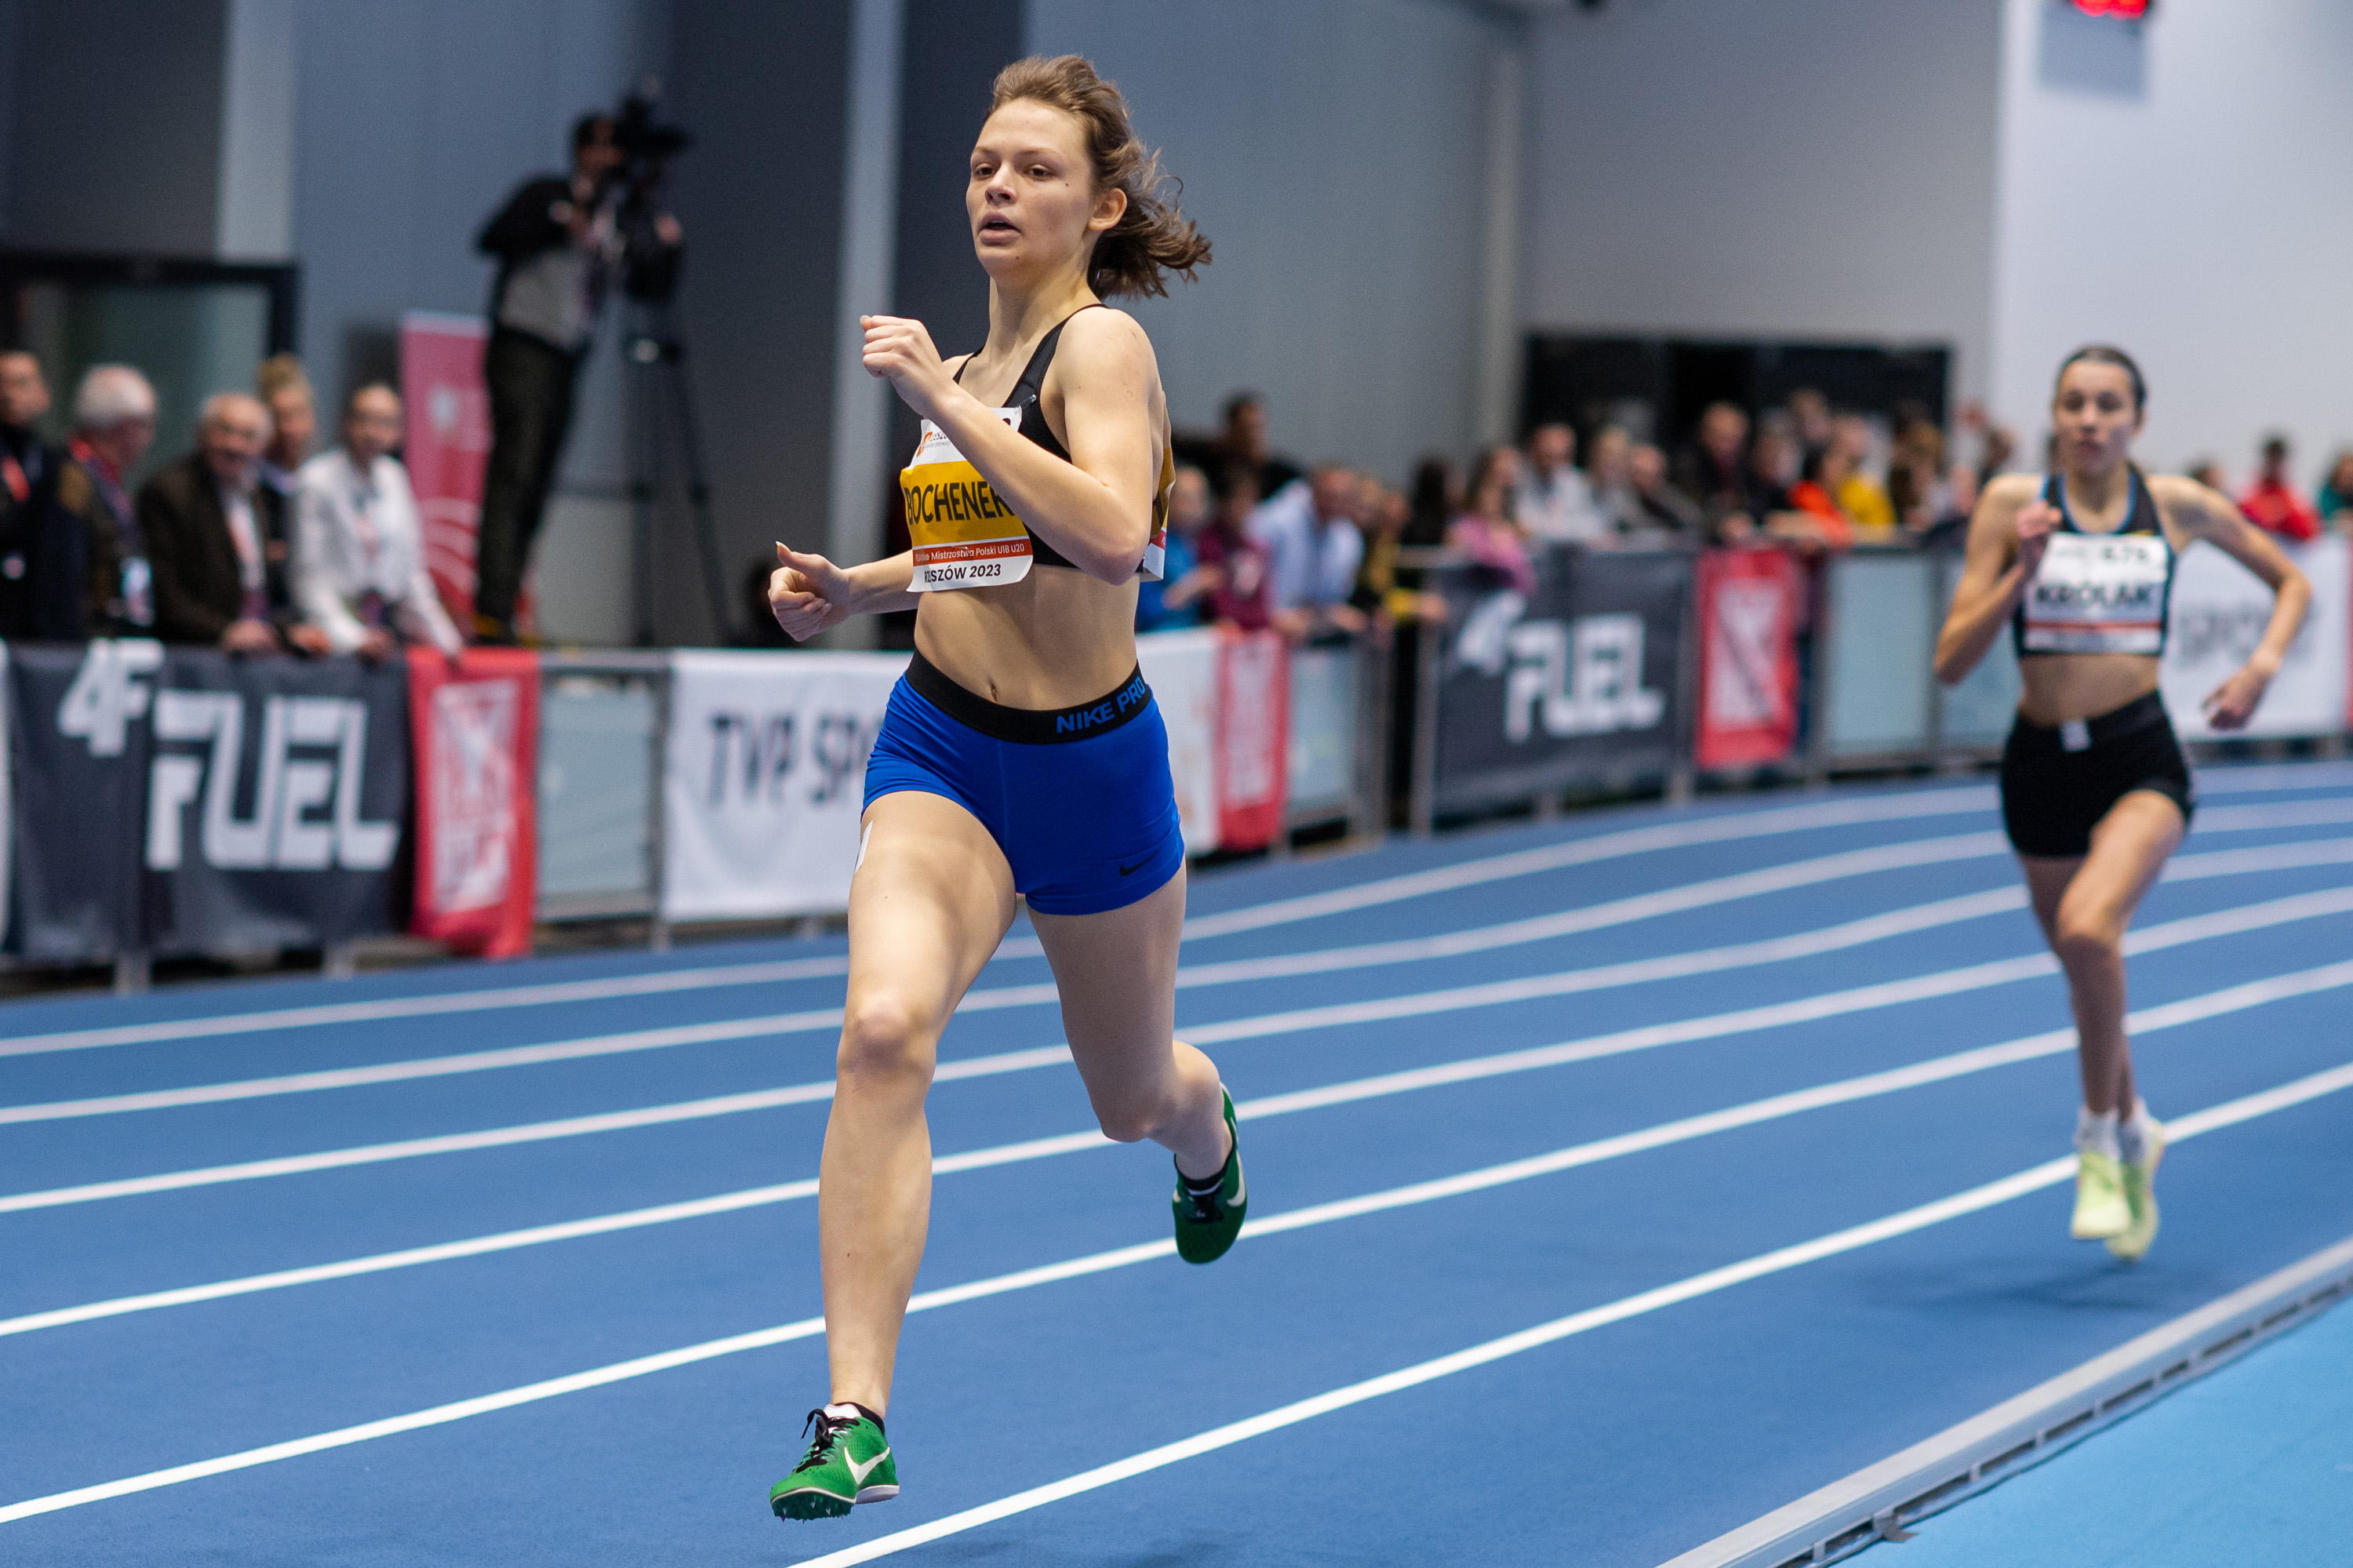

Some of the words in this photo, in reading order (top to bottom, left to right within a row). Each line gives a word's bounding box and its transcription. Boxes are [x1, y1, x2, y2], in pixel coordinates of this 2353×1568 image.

[931, 548, 974, 561] Mistrzostwa
[976, 545, 996, 556] Polski
[997, 544, 1009, 555] U18
[1010, 543, 1024, 553] U20
[969, 563, 1001, 578] 2023
[57, 638, 164, 757] 4F
[1056, 701, 1115, 733] NIKE
[1116, 675, 1146, 714] PRO
[146, 689, 399, 871] FUEL
[707, 711, 795, 808] TVP
